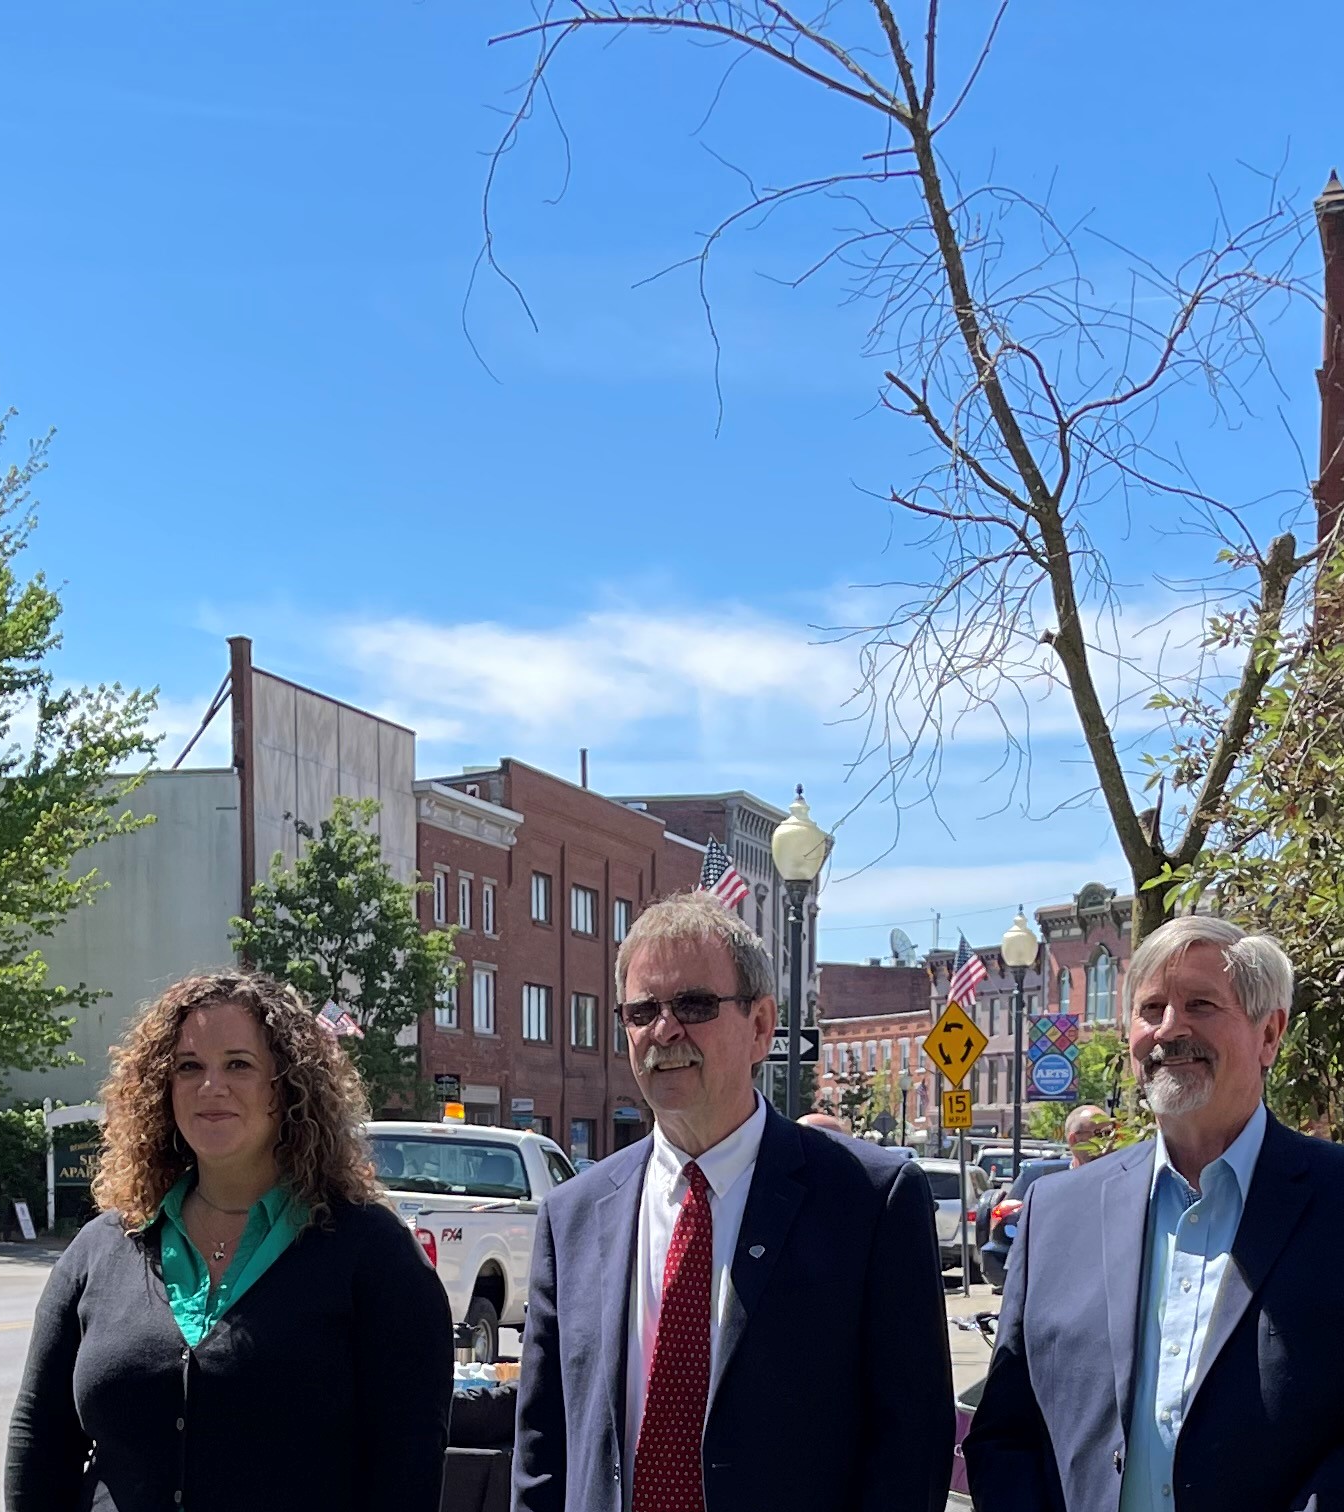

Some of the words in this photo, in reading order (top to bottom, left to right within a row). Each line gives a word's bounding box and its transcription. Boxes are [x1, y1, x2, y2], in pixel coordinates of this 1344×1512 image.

[772, 1039, 790, 1052] AY
[1036, 1068, 1070, 1079] ARTS
[948, 1095, 967, 1114] 15
[441, 1227, 463, 1241] FX4
